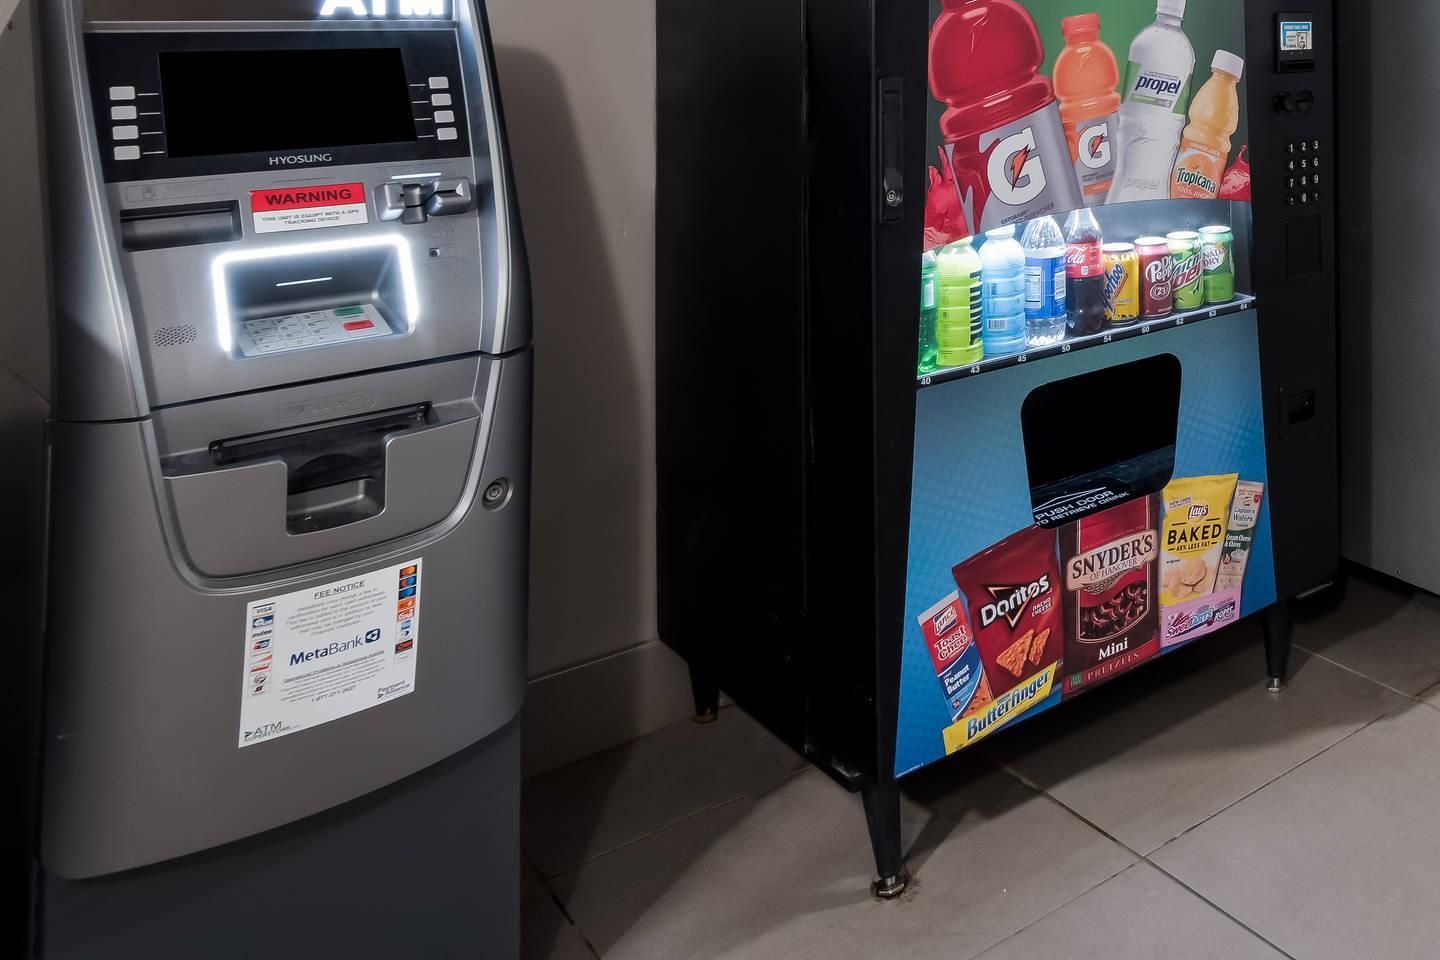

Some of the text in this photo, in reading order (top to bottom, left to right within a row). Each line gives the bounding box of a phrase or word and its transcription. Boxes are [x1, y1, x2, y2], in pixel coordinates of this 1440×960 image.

[1135, 75, 1182, 95] propel
[1078, 122, 1112, 169] G
[1290, 140, 1318, 152] 1 2 3
[268, 153, 332, 166] HYOSUNG
[987, 126, 1048, 206] G
[1289, 158, 1318, 170] 4 5 6
[1177, 168, 1216, 194] Tropicana
[1290, 174, 1318, 188] 7 8 9
[264, 189, 352, 206] WARNING
[1302, 192, 1306, 202] 0
[1204, 257, 1220, 267] DRY
[920, 377, 930, 385] 40
[970, 366, 980, 374] 43
[1018, 354, 1026, 362] 45
[1062, 344, 1070, 352] 50
[1142, 326, 1150, 334] 60
[1034, 490, 1114, 520] PUSH DOOR
[1036, 491, 1131, 526] TO RETRIEVE DRINK
[1233, 514, 1253, 522] Wafers
[1167, 524, 1222, 545] BAKED
[1188, 542, 1200, 550] LESS
[1072, 534, 1153, 580] SNYDER'S
[1090, 558, 1138, 582] OF HANOVER
[314, 580, 366, 600] FEE NOTICE
[256, 606, 272, 614] VISA
[980, 575, 1050, 627] Doritos
[1032, 604, 1052, 618] CHEESE
[934, 626, 966, 650] Toast
[938, 634, 968, 661] Chee
[289, 633, 364, 667] MetaBank
[1098, 637, 1128, 661] Mini
[944, 664, 970, 686] Peanut
[1087, 653, 1139, 680] PRETZELS
[946, 674, 970, 695] Butter
[967, 671, 1050, 740] Butterfinger
[254, 721, 283, 736] ATM
